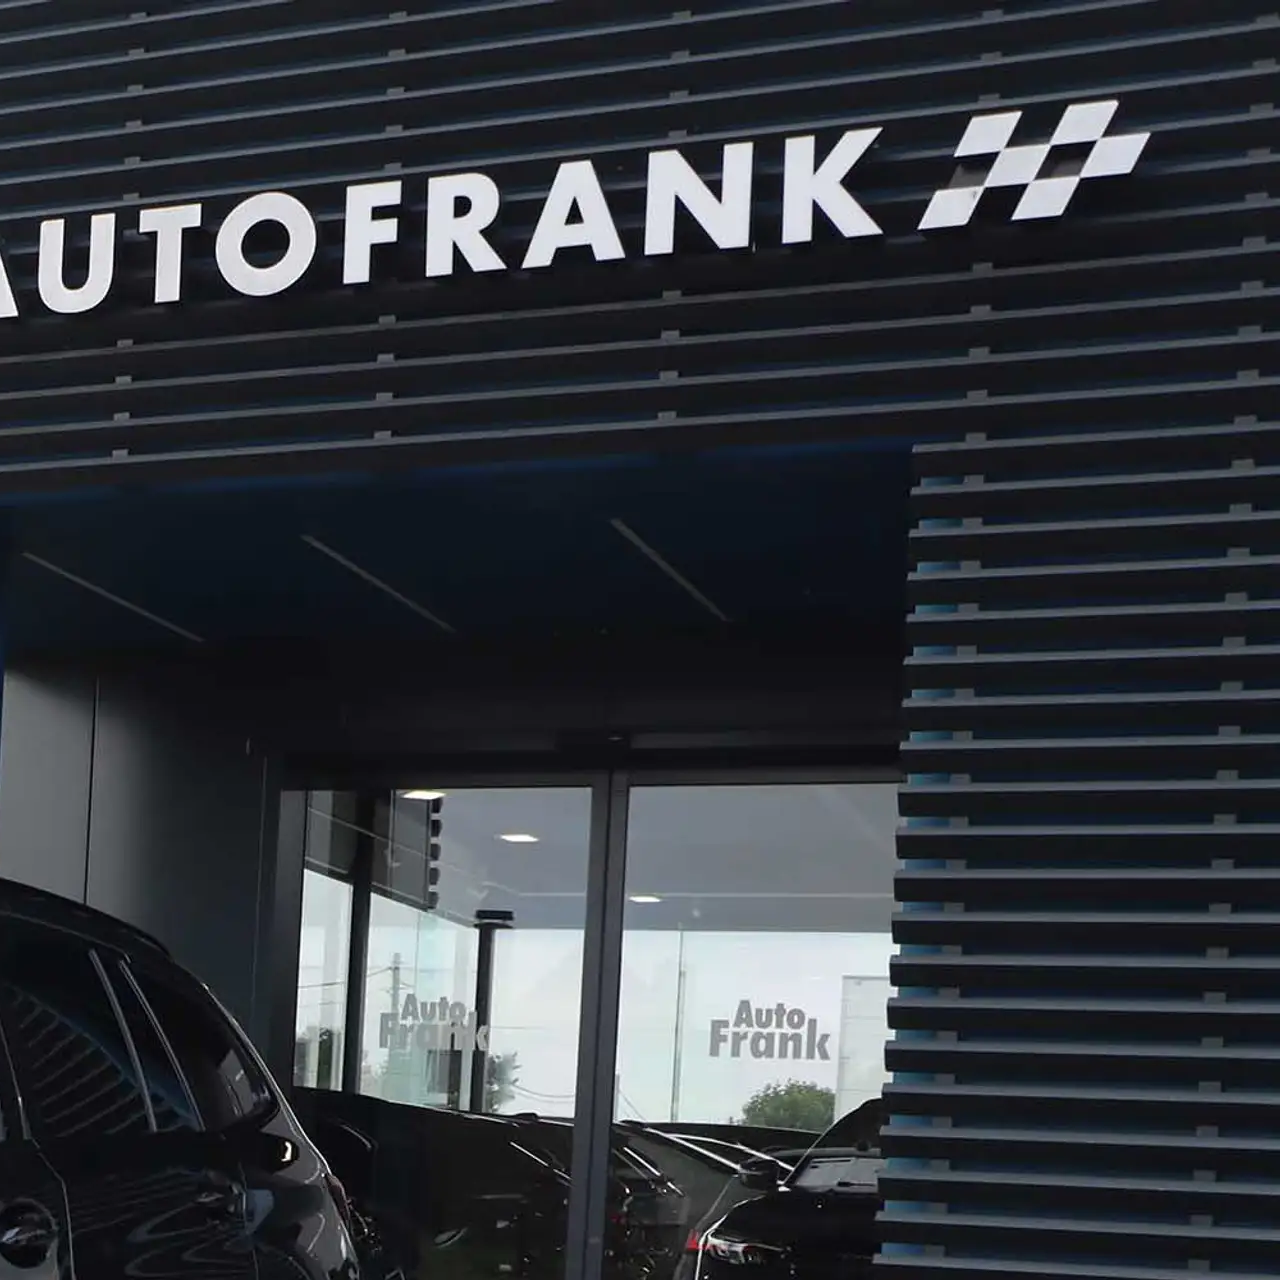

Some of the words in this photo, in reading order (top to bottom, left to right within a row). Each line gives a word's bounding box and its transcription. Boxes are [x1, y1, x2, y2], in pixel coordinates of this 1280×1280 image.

[401, 993, 466, 1022] Auto
[733, 999, 806, 1030] Auto
[379, 1011, 490, 1051] Frank
[709, 1018, 831, 1061] Frank
